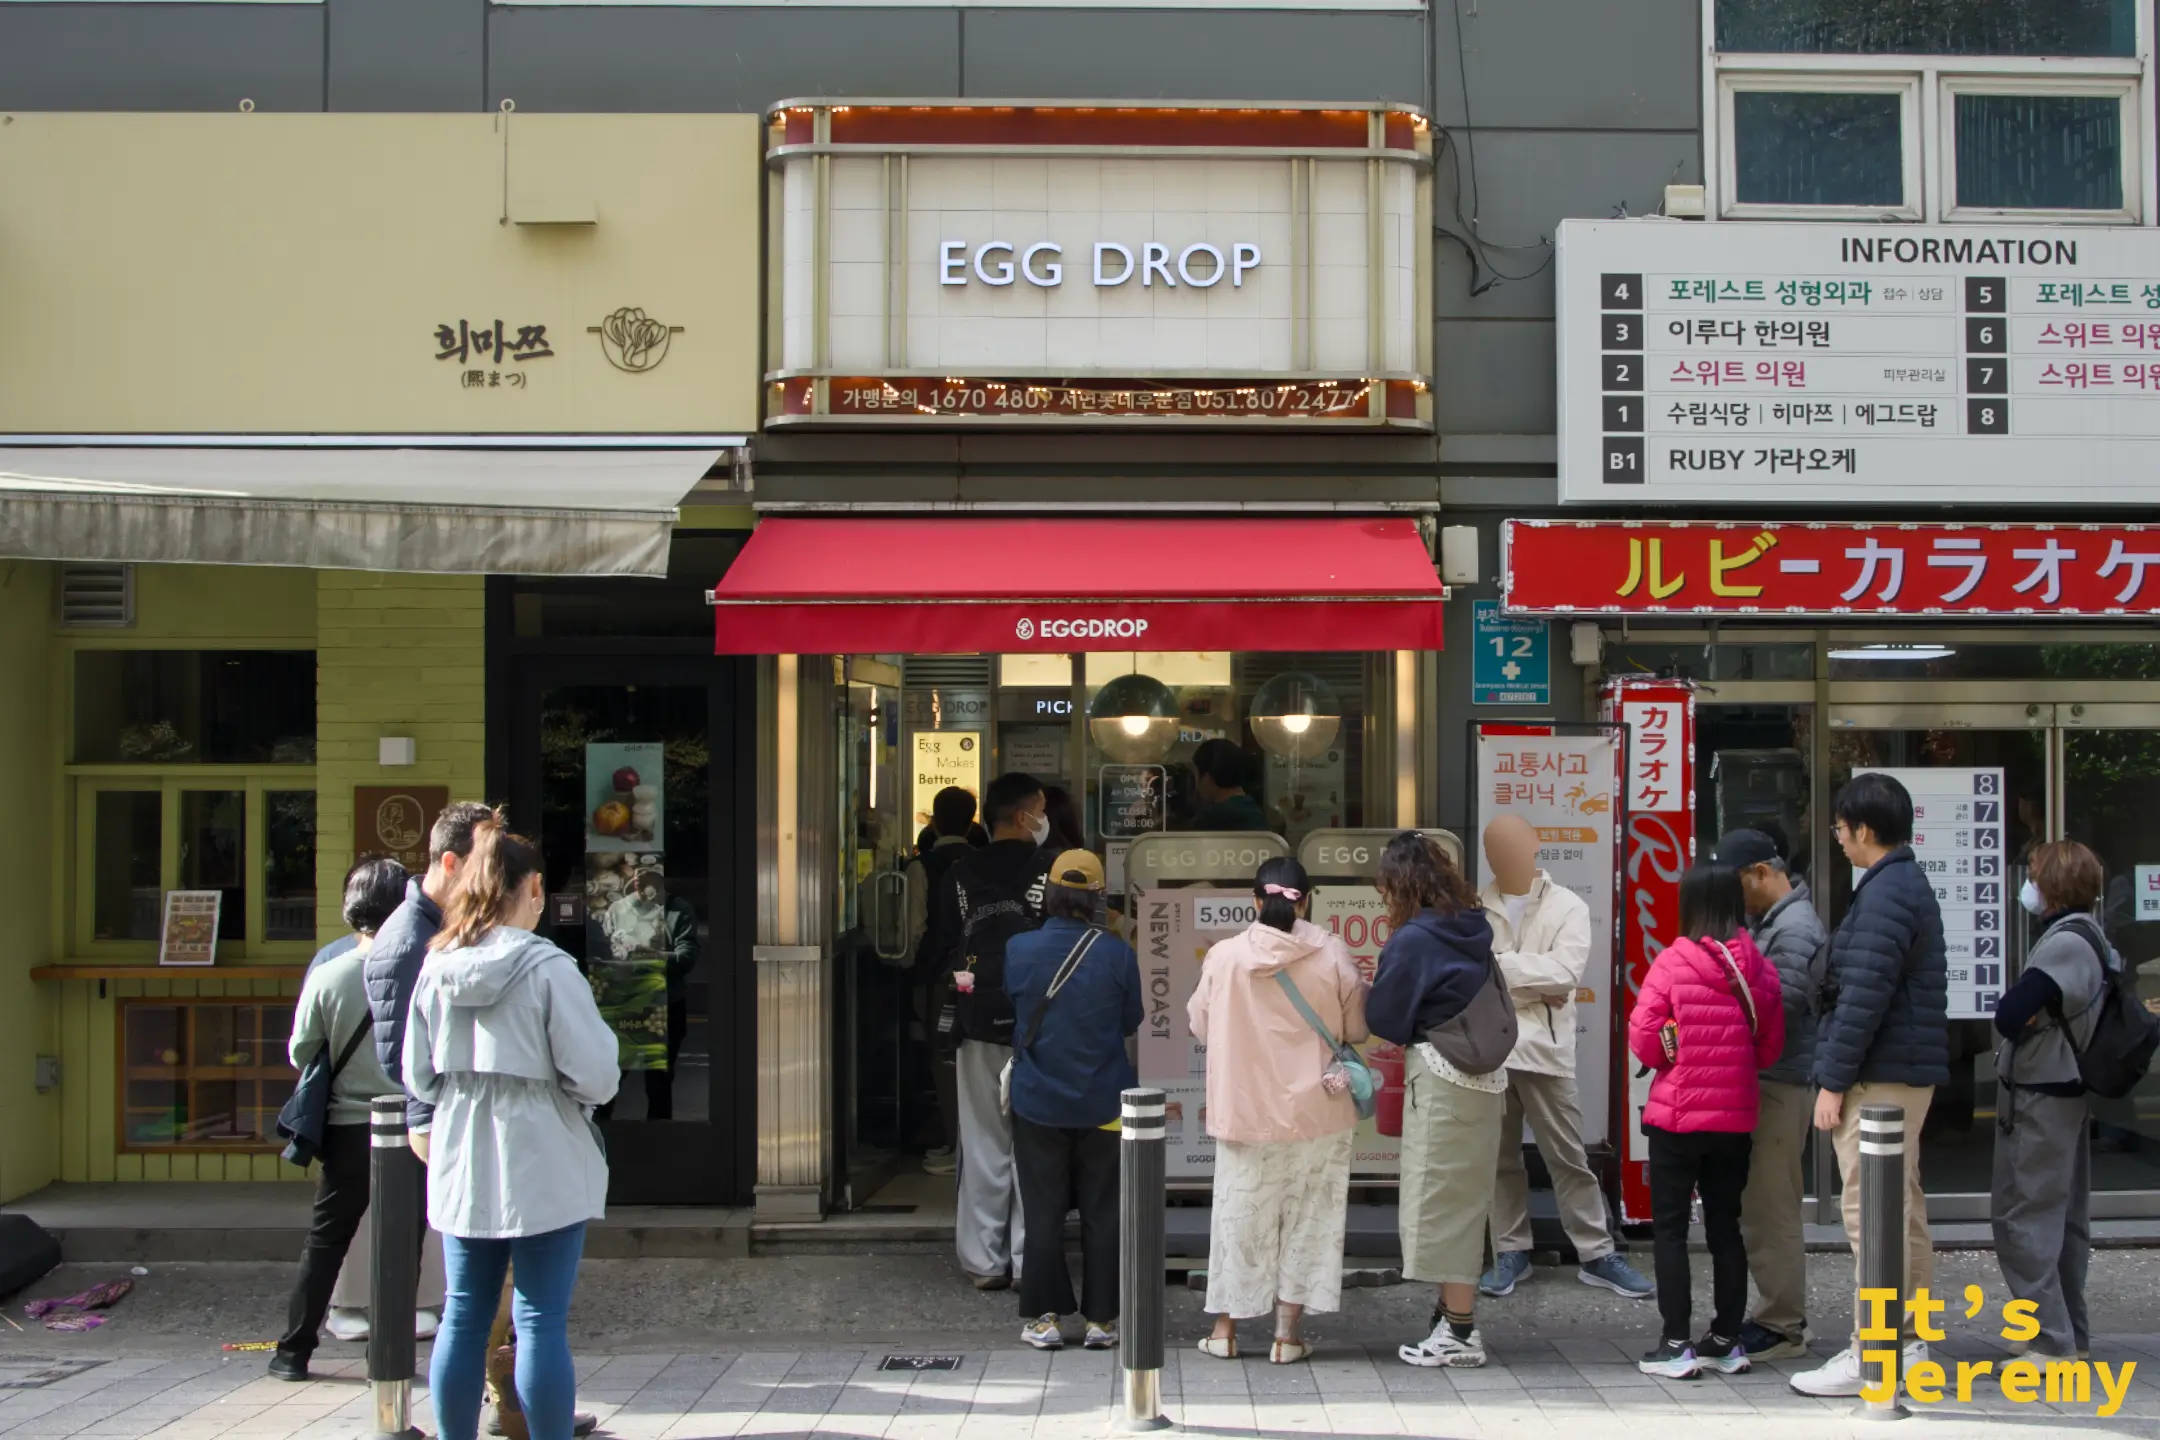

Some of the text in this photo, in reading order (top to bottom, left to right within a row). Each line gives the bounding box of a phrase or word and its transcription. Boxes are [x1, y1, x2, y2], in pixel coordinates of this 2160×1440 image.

[1840, 236, 2078, 267] INFORMATION
[940, 240, 1262, 288] EGG DROP
[1613, 283, 1630, 300] 4
[1668, 279, 1766, 304] 포레스트
[1774, 280, 1873, 306] 성형외과
[1979, 286, 1993, 304] 5
[2036, 283, 2132, 308] 포레스트
[433, 318, 555, 365] 희마쯔
[1615, 319, 1831, 347] 3 이루다 한의원
[1979, 327, 1993, 345] 6
[2037, 323, 2114, 349] 스위트
[1615, 364, 1630, 382] 2
[1669, 360, 1747, 386] 스위트
[1755, 360, 1806, 388] 의원
[1979, 367, 1994, 385] 7
[2038, 363, 2115, 389] 스위트
[929, 388, 986, 409] 1670
[1196, 389, 1355, 410] 051.807.2477
[1616, 402, 1938, 428] 1 수림식당 히마쯔 에그드랍
[1980, 407, 1995, 425] 8
[1609, 448, 1857, 474] B1 RUBY 가라오케
[1040, 618, 1149, 638] EGGDROP
[1489, 636, 1534, 657] 12
[944, 701, 988, 714] DROP
[918, 738, 941, 754] Egg
[937, 757, 976, 769] Makes
[1493, 751, 1589, 778] 교통사고
[1637, 706, 1669, 808] カラオケ
[918, 773, 958, 785] Better
[1978, 774, 1994, 795] 8
[1492, 782, 1555, 806] 클리닉
[1979, 802, 1994, 823] 7
[1979, 829, 1995, 850] 6
[1145, 849, 1271, 867] EGG DROP
[1318, 846, 1370, 864] EGG
[1534, 848, 1560, 861] 담금
[1979, 856, 1994, 877] 5
[1978, 883, 1995, 904] 4
[1200, 905, 1257, 926] 5,900
[1980, 910, 1995, 931] 3
[1980, 937, 1995, 958] 2
[1150, 902, 1170, 1040] NEW TOAST
[1982, 965, 1991, 985] 1
[1981, 991, 1996, 1012] F
